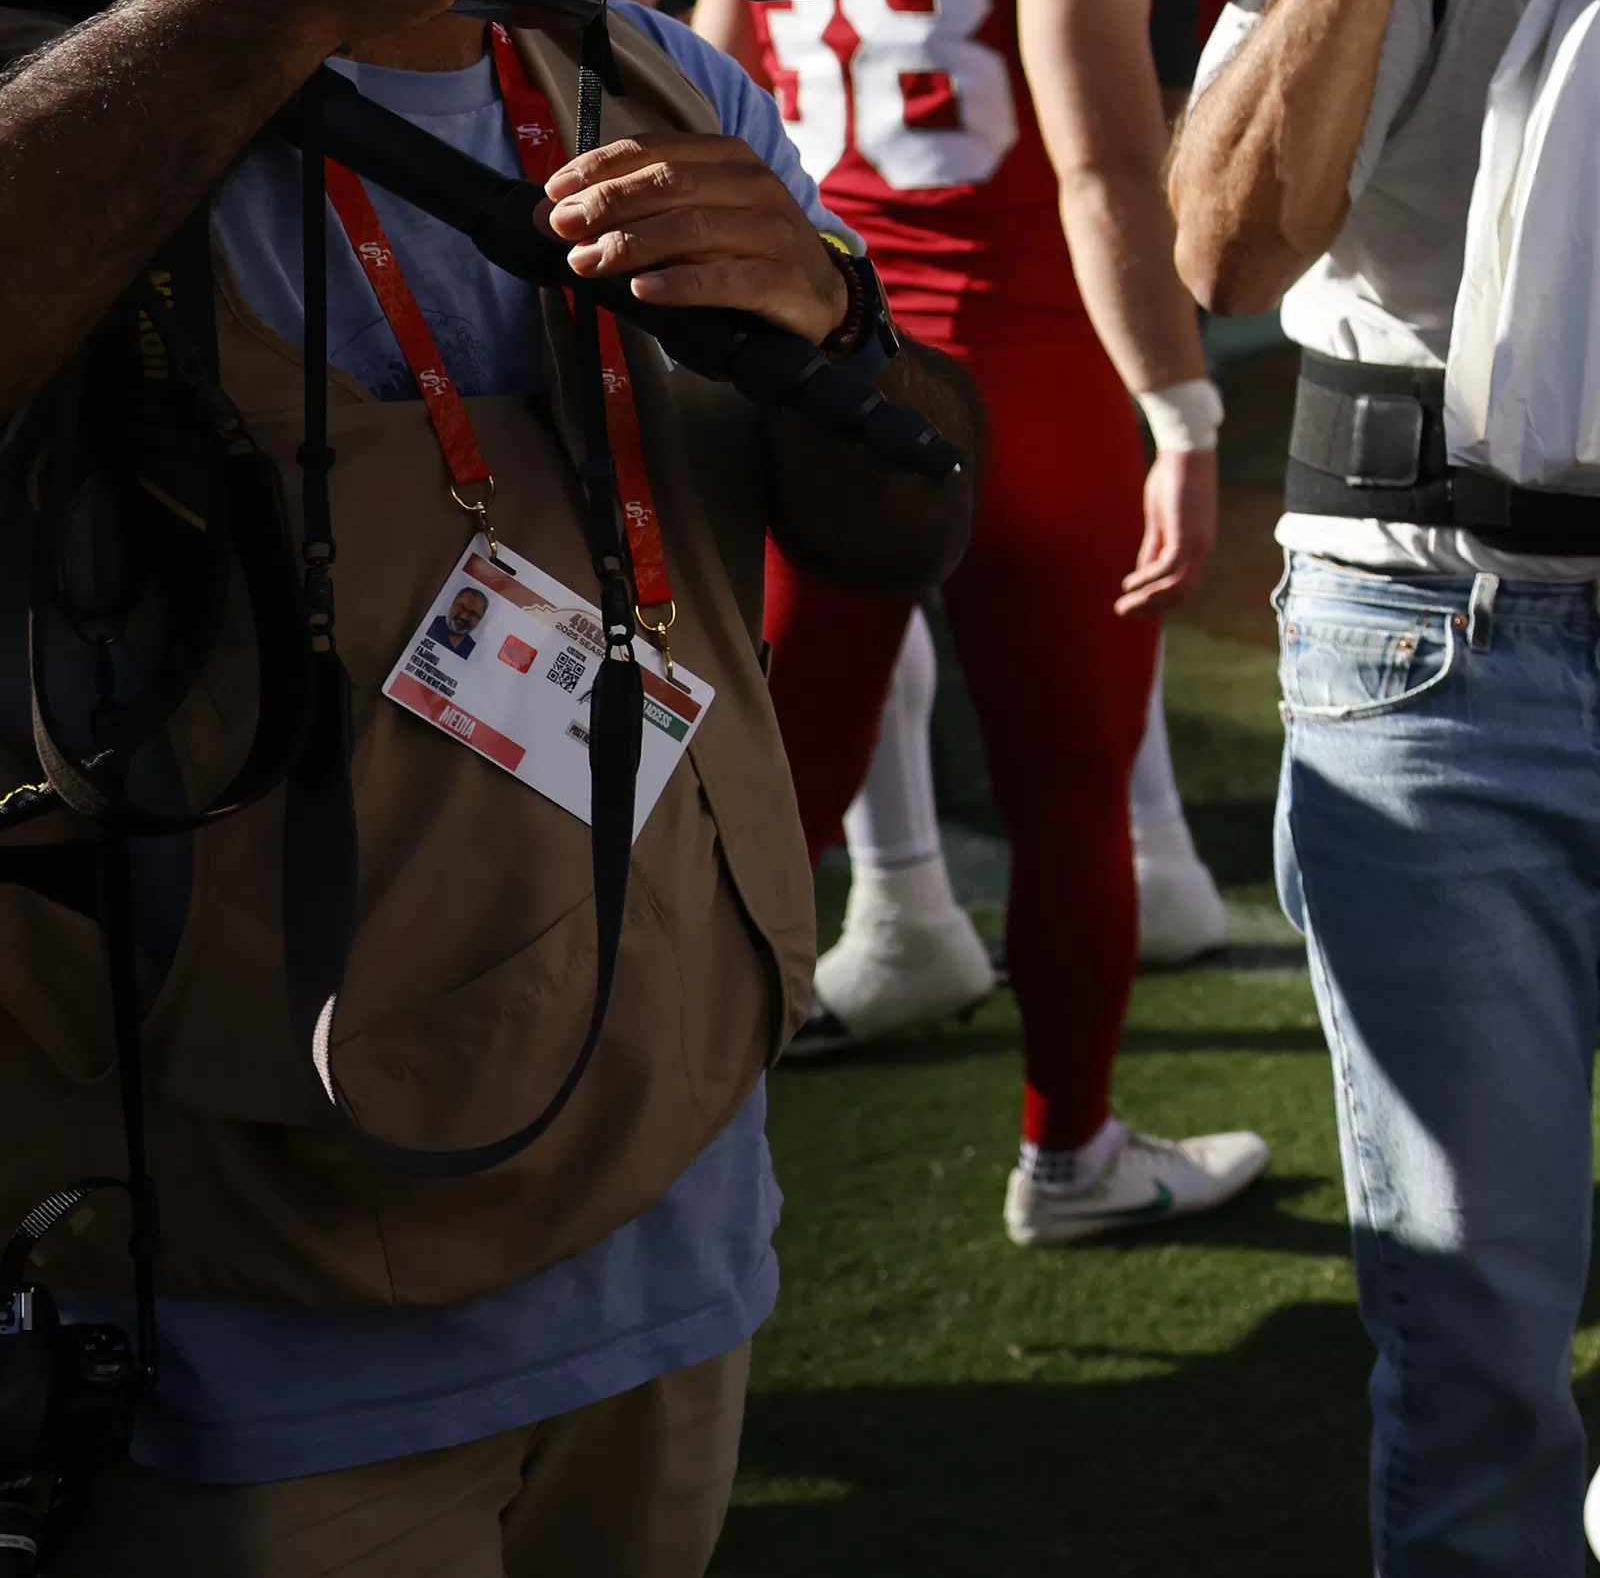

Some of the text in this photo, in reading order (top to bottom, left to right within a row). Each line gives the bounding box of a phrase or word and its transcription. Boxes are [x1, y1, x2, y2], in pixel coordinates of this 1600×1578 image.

[554, 622, 579, 642] 2025
[438, 705, 477, 740] MEDIA
[643, 703, 674, 729] ACCESS
